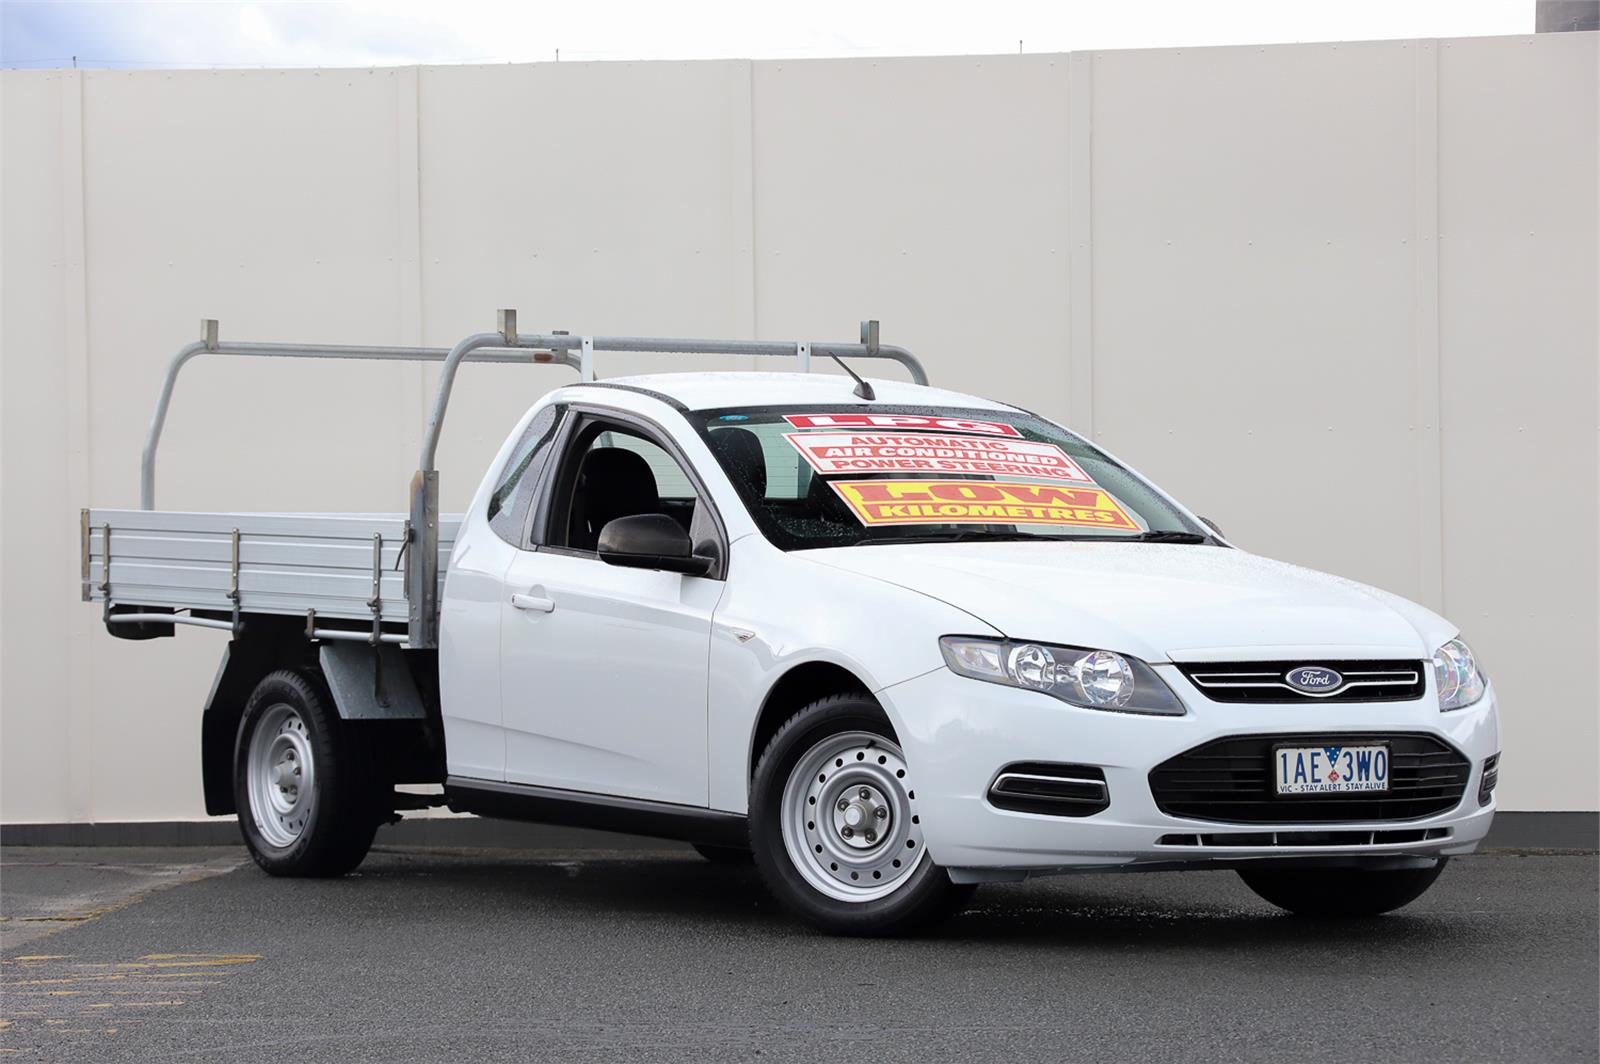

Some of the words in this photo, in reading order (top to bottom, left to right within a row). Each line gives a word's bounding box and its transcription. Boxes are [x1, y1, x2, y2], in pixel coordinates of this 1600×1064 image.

[807, 416, 1006, 434] LPG
[851, 436, 1009, 451] AUTOMATIC
[824, 447, 873, 457] AIR
[878, 447, 1058, 465] CONDITIONED
[831, 459, 935, 469] POWER
[937, 460, 1072, 478] STEERING
[850, 484, 1099, 507] LOW
[878, 505, 1116, 523] KILOMETRES
[1300, 671, 1330, 685] Ford
[1280, 752, 1322, 784] 1AE
[1280, 785, 1293, 793] VIC
[1300, 784, 1319, 793] STAY
[1319, 783, 1341, 792] ALERT
[1345, 783, 1363, 791] STAY
[1365, 782, 1386, 790] ALIVE
